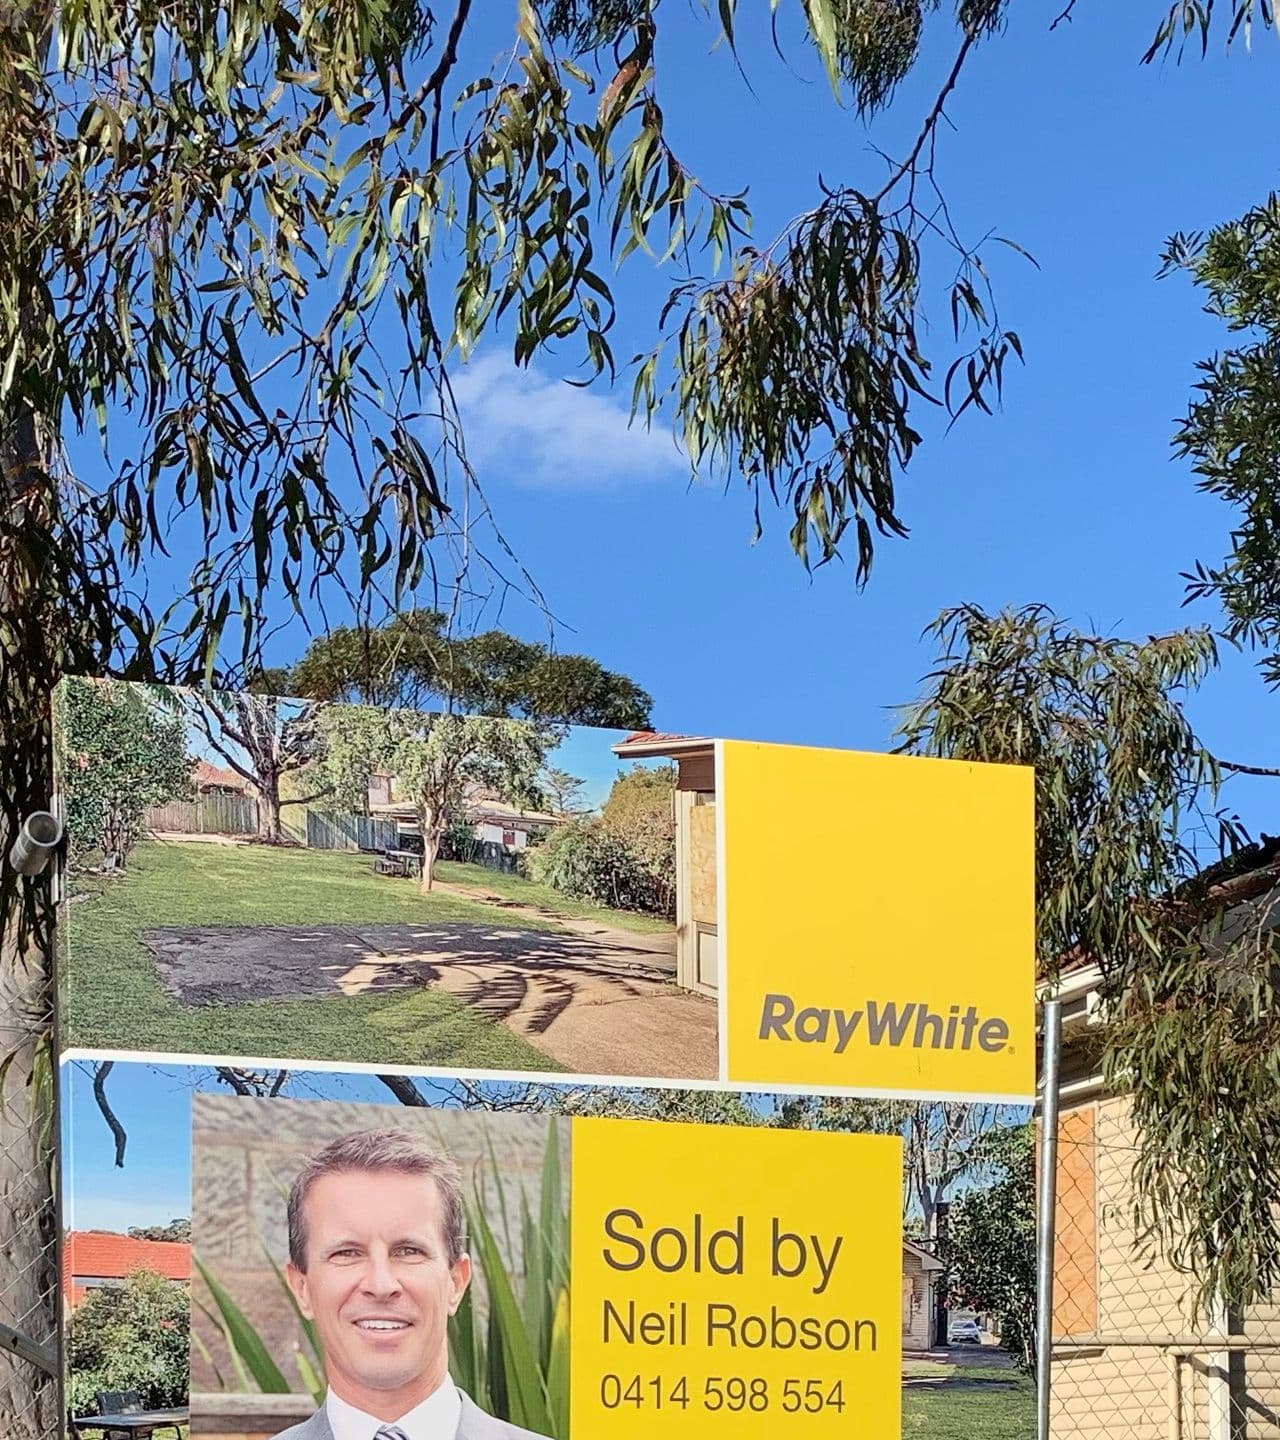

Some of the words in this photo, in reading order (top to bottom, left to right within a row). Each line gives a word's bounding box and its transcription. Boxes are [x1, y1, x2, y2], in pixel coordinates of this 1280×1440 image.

[603, 1208, 745, 1274] Sold
[772, 1218, 843, 1294] by
[603, 1299, 687, 1346] Neil
[708, 1304, 878, 1351] Robson
[600, 1375, 690, 1409] 0414
[704, 1378, 768, 1411] 598
[782, 1379, 845, 1413] 554
